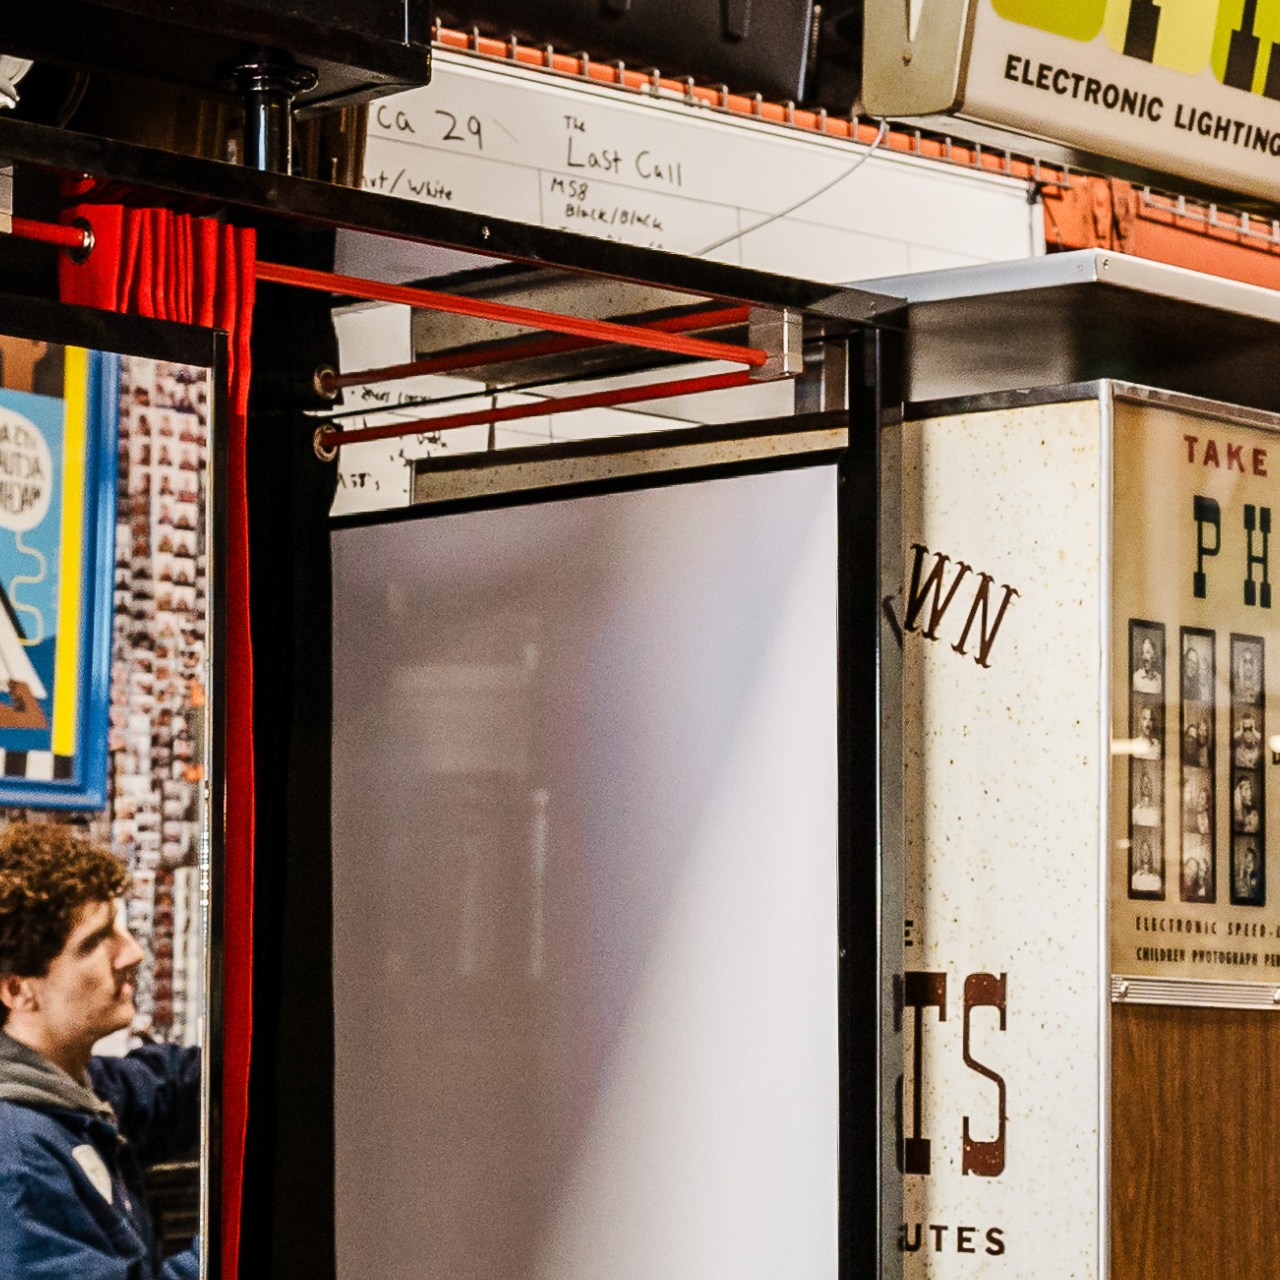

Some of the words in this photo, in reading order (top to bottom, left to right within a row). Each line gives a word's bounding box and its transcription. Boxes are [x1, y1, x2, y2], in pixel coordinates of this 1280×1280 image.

[1004, 54, 1164, 122] ELECTRONIC
[435, 110, 483, 149] 29
[563, 115, 586, 132] The
[567, 136, 622, 174] Last
[635, 150, 682, 187] Call
[1182, 434, 1269, 477] TAKE
[1136, 916, 1216, 934] ELECTRONIC
[1136, 947, 1185, 962] CHILDREN
[1192, 949, 1258, 965] PHOTOGRAPH
